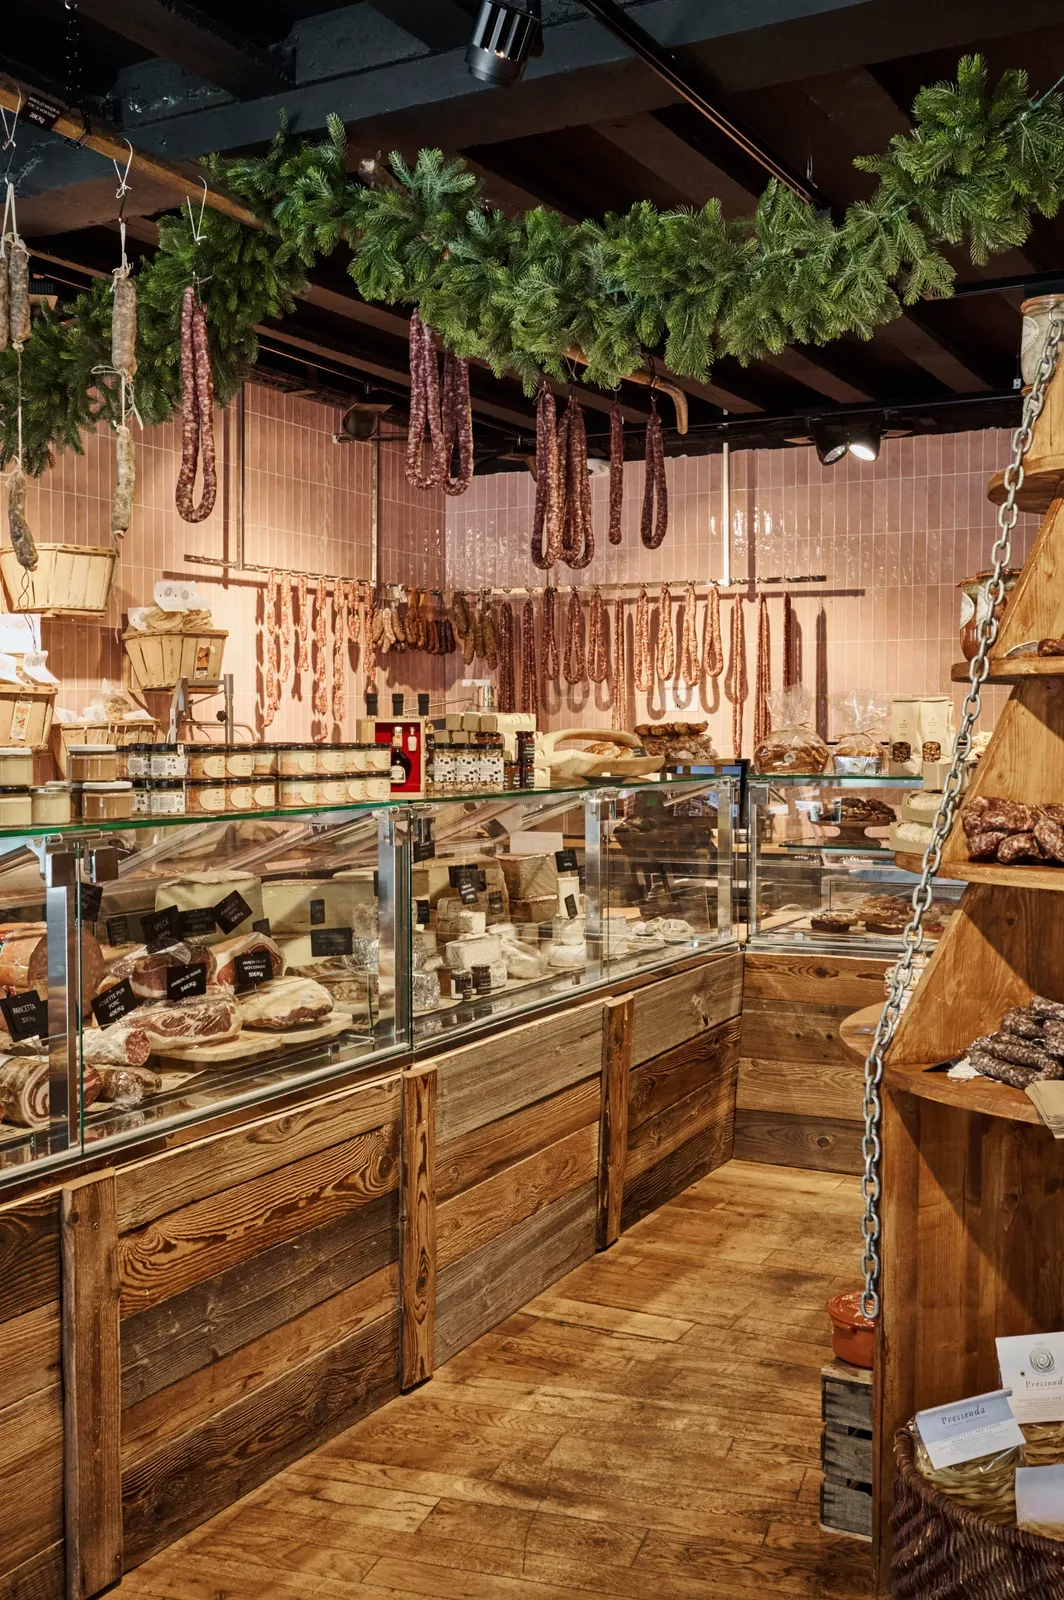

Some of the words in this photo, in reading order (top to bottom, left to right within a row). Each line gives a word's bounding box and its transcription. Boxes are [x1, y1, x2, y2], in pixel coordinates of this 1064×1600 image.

[153, 918, 170, 932] SPECK
[12, 1003, 37, 1015] PANCETTA
[108, 998, 121, 1010] PORC
[1025, 1376, 1064, 1388] Pressend
[941, 1405, 987, 1426] Pressenda
